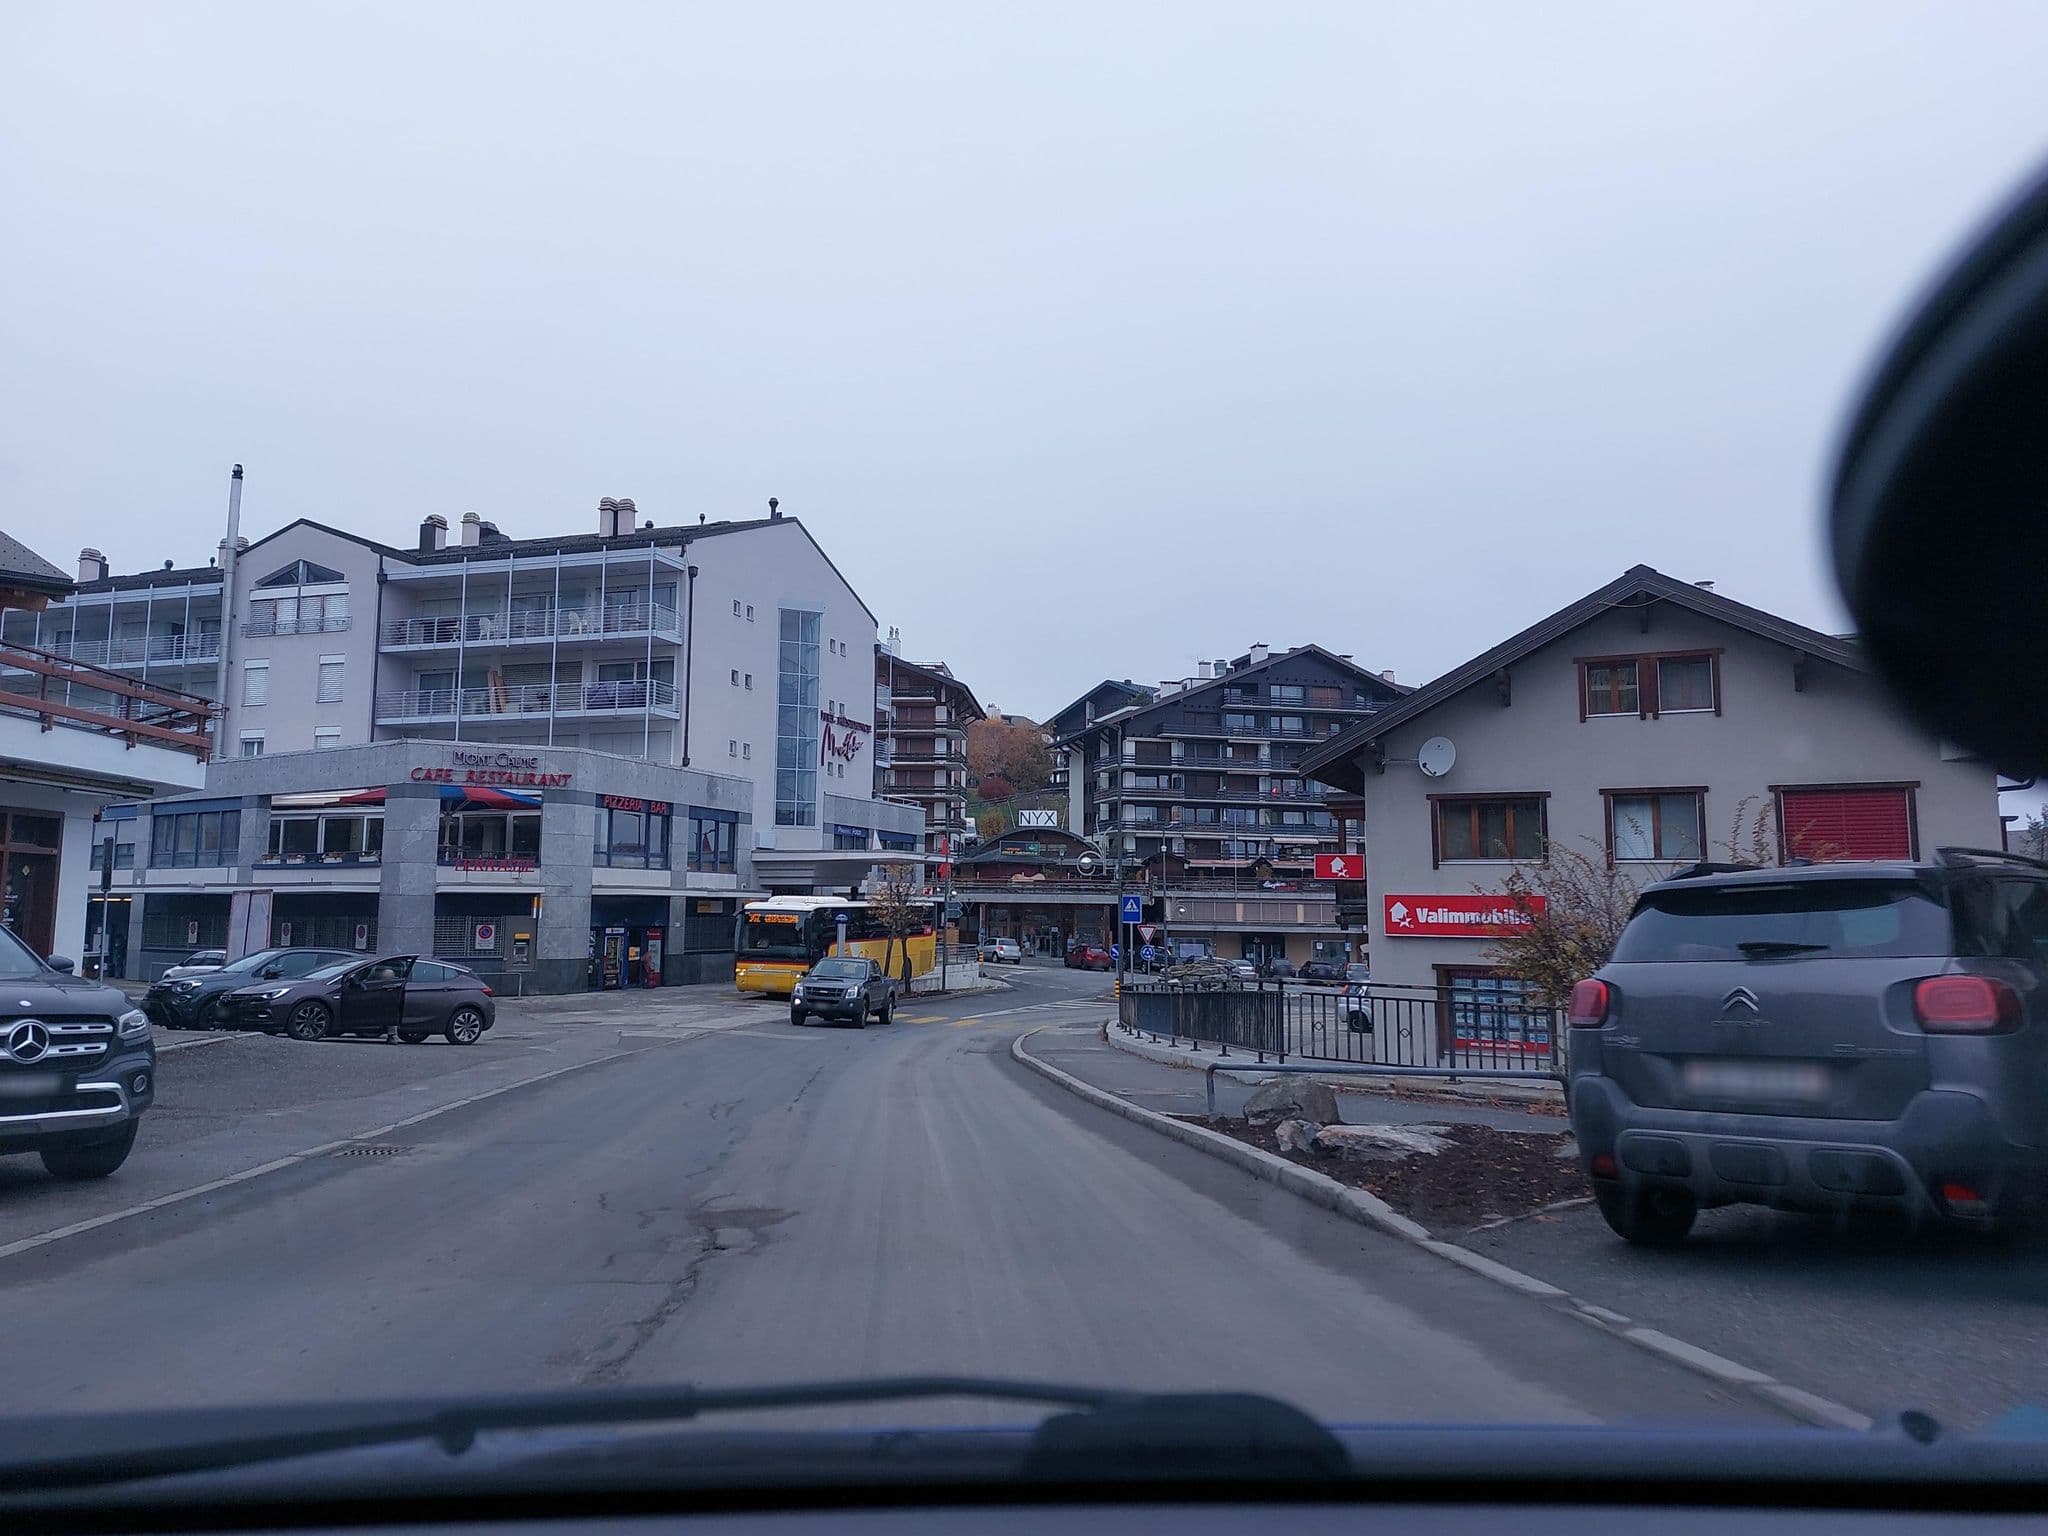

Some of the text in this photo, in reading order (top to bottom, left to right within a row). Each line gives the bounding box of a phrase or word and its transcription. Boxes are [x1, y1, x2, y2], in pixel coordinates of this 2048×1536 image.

[465, 768, 572, 787] RESTAURANT
[604, 795, 666, 814] PIZZERIA BAR
[1019, 811, 1056, 825] NYX
